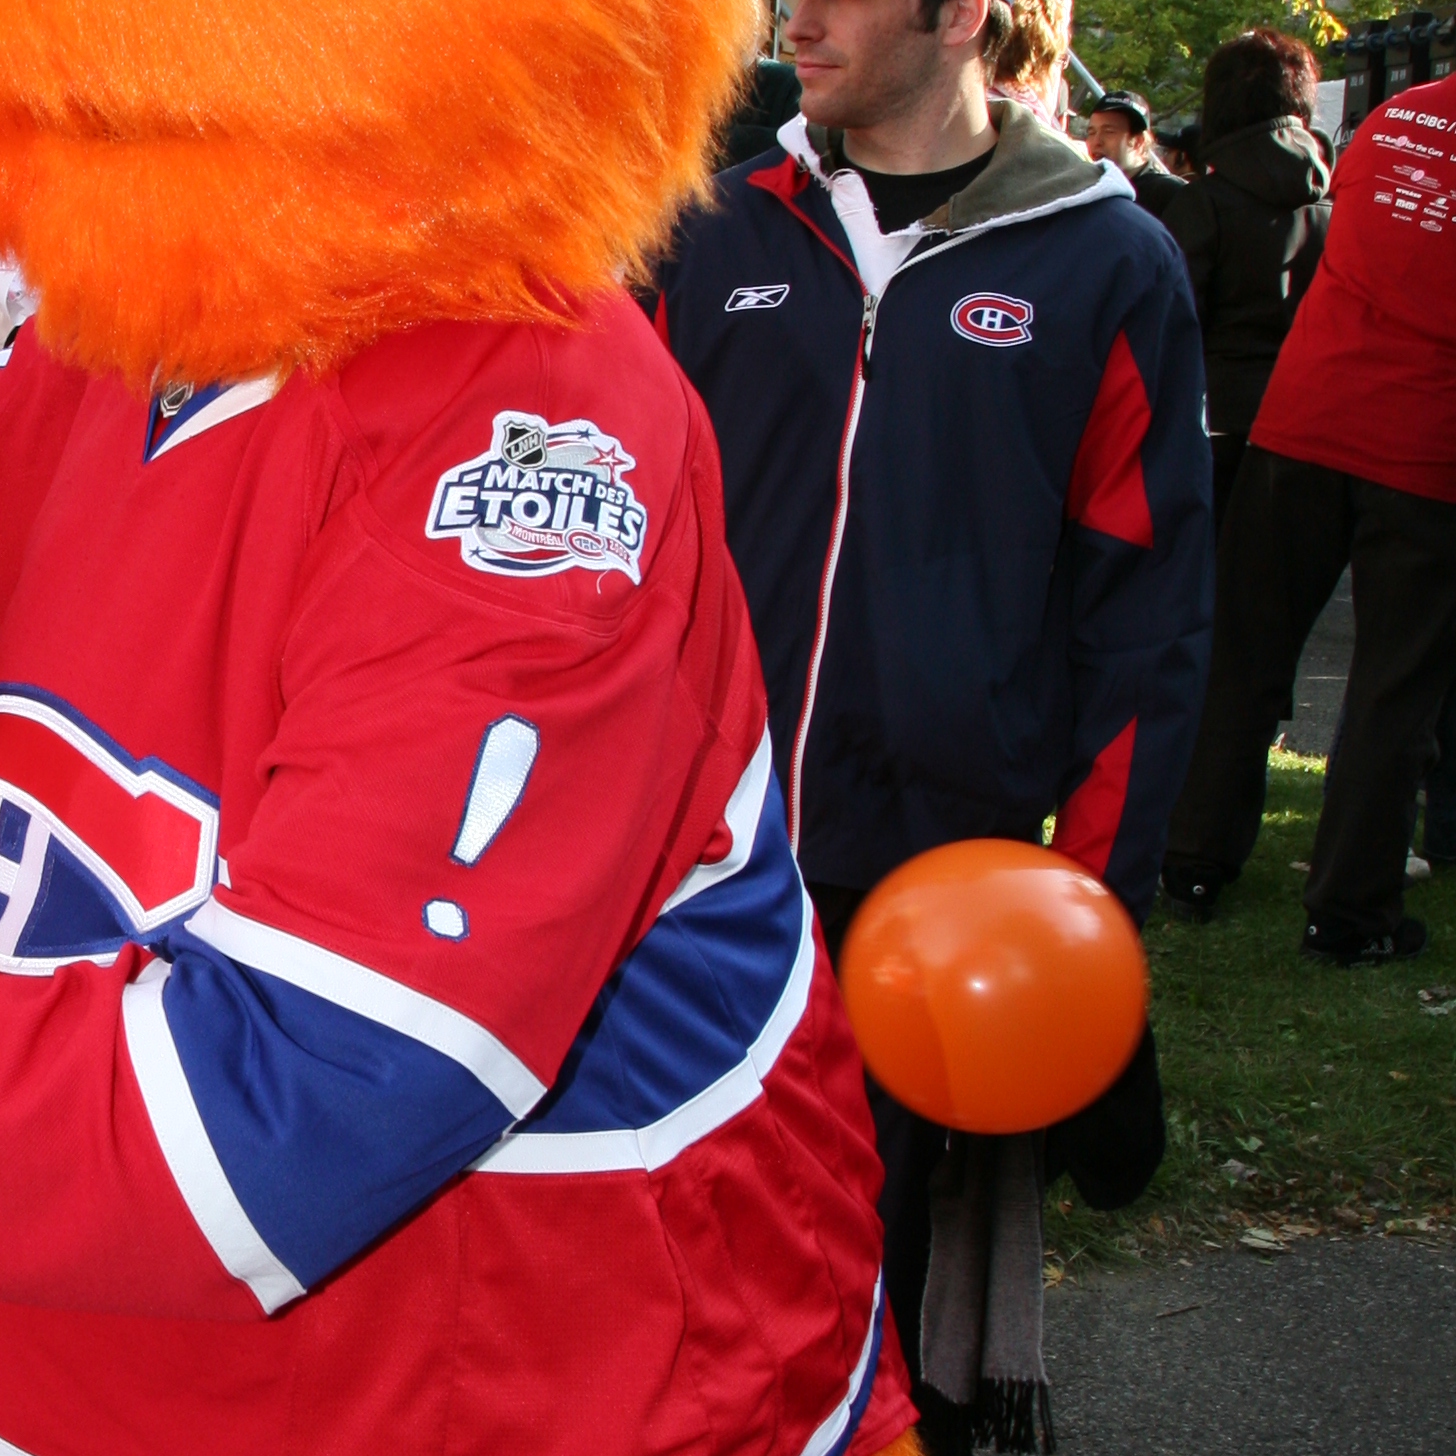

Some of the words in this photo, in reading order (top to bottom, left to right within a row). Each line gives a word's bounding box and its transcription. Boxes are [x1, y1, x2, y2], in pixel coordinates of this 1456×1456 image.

[1384, 107, 1415, 121] TEAM
[1415, 113, 1447, 130] CIBC
[509, 433, 540, 459] LNH
[483, 464, 594, 497] MATCH
[594, 482, 627, 505] DES
[437, 470, 643, 549] ÉTOILES
[511, 524, 565, 547] MONTRÉAL
